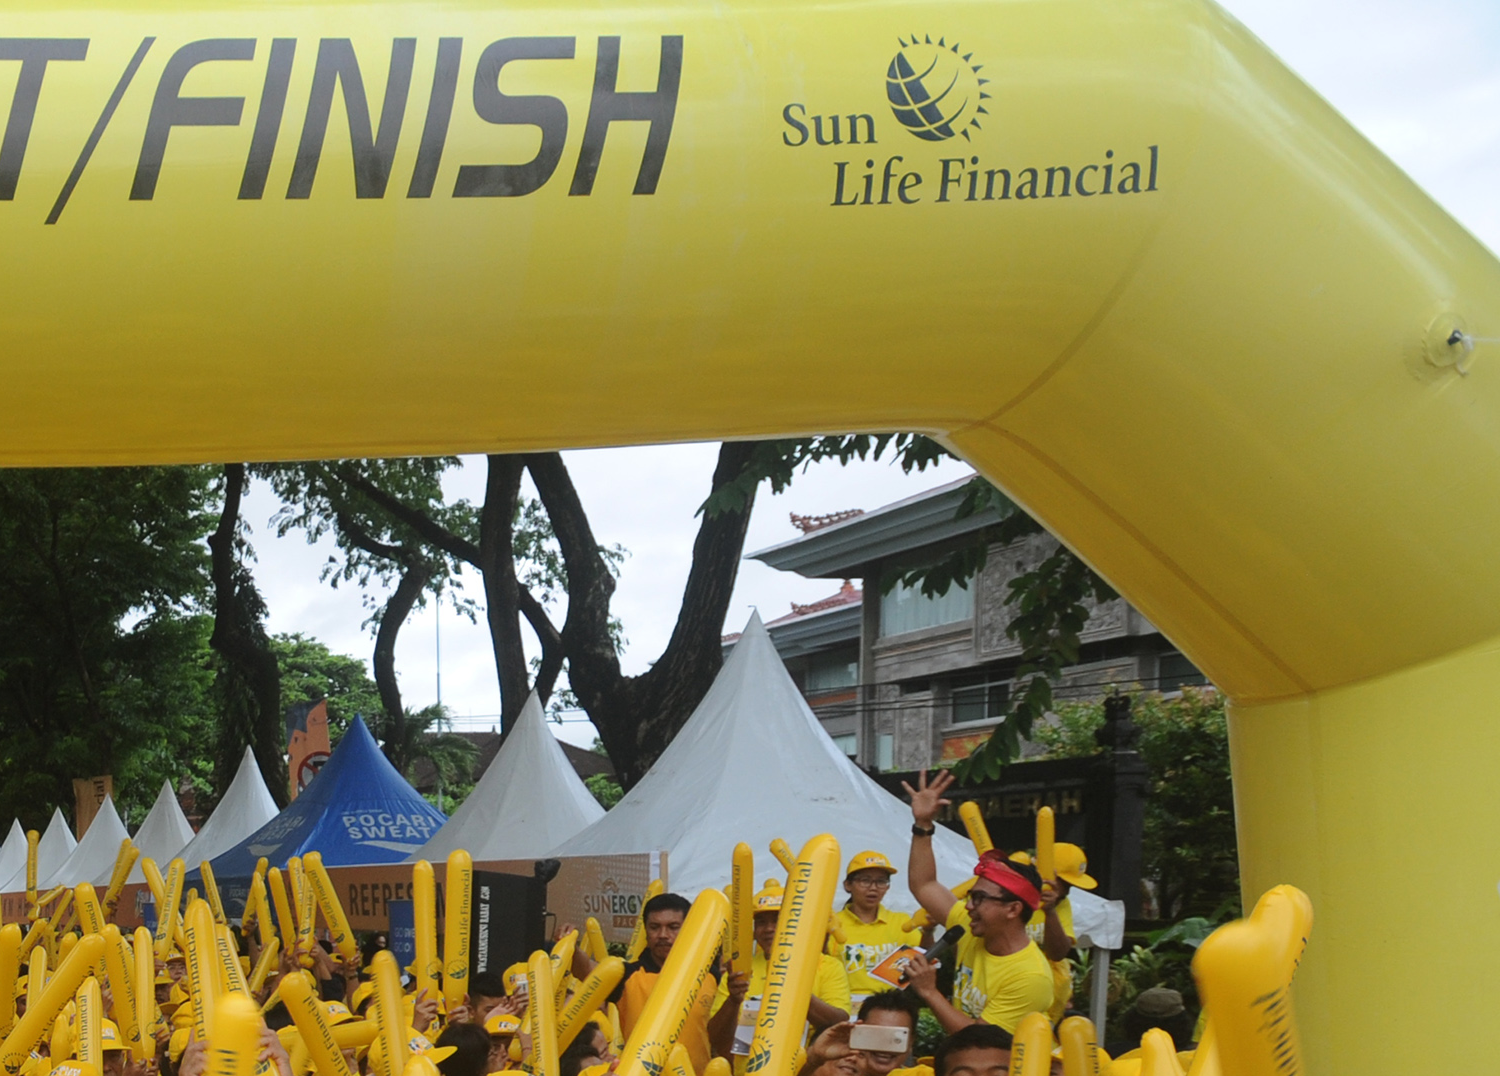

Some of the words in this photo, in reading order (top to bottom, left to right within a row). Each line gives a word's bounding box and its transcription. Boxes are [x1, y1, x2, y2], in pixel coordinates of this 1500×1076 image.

[782, 102, 877, 147] Sun
[830, 155, 922, 207] Life
[934, 145, 1160, 203] Financial
[342, 813, 437, 828] POCARI
[348, 826, 431, 839] SWEAT
[460, 868, 470, 914] Financial
[779, 860, 814, 947] Financial
[460, 915, 469, 936] Life
[185, 927, 201, 995] Financial
[217, 937, 242, 993] Financial
[460, 939, 468, 957] Sun
[769, 950, 792, 988] Life
[192, 996, 204, 1023] Life
[529, 971, 539, 1020] Financial
[567, 975, 603, 1016] Financial
[761, 990, 782, 1028] Sun
[79, 994, 89, 1041] Financial
[303, 995, 336, 1053] Financial
[533, 1021, 542, 1044] Life
[80, 1043, 88, 1063] Life
[330, 1050, 349, 1075] Life
[535, 1045, 543, 1064] Sun
